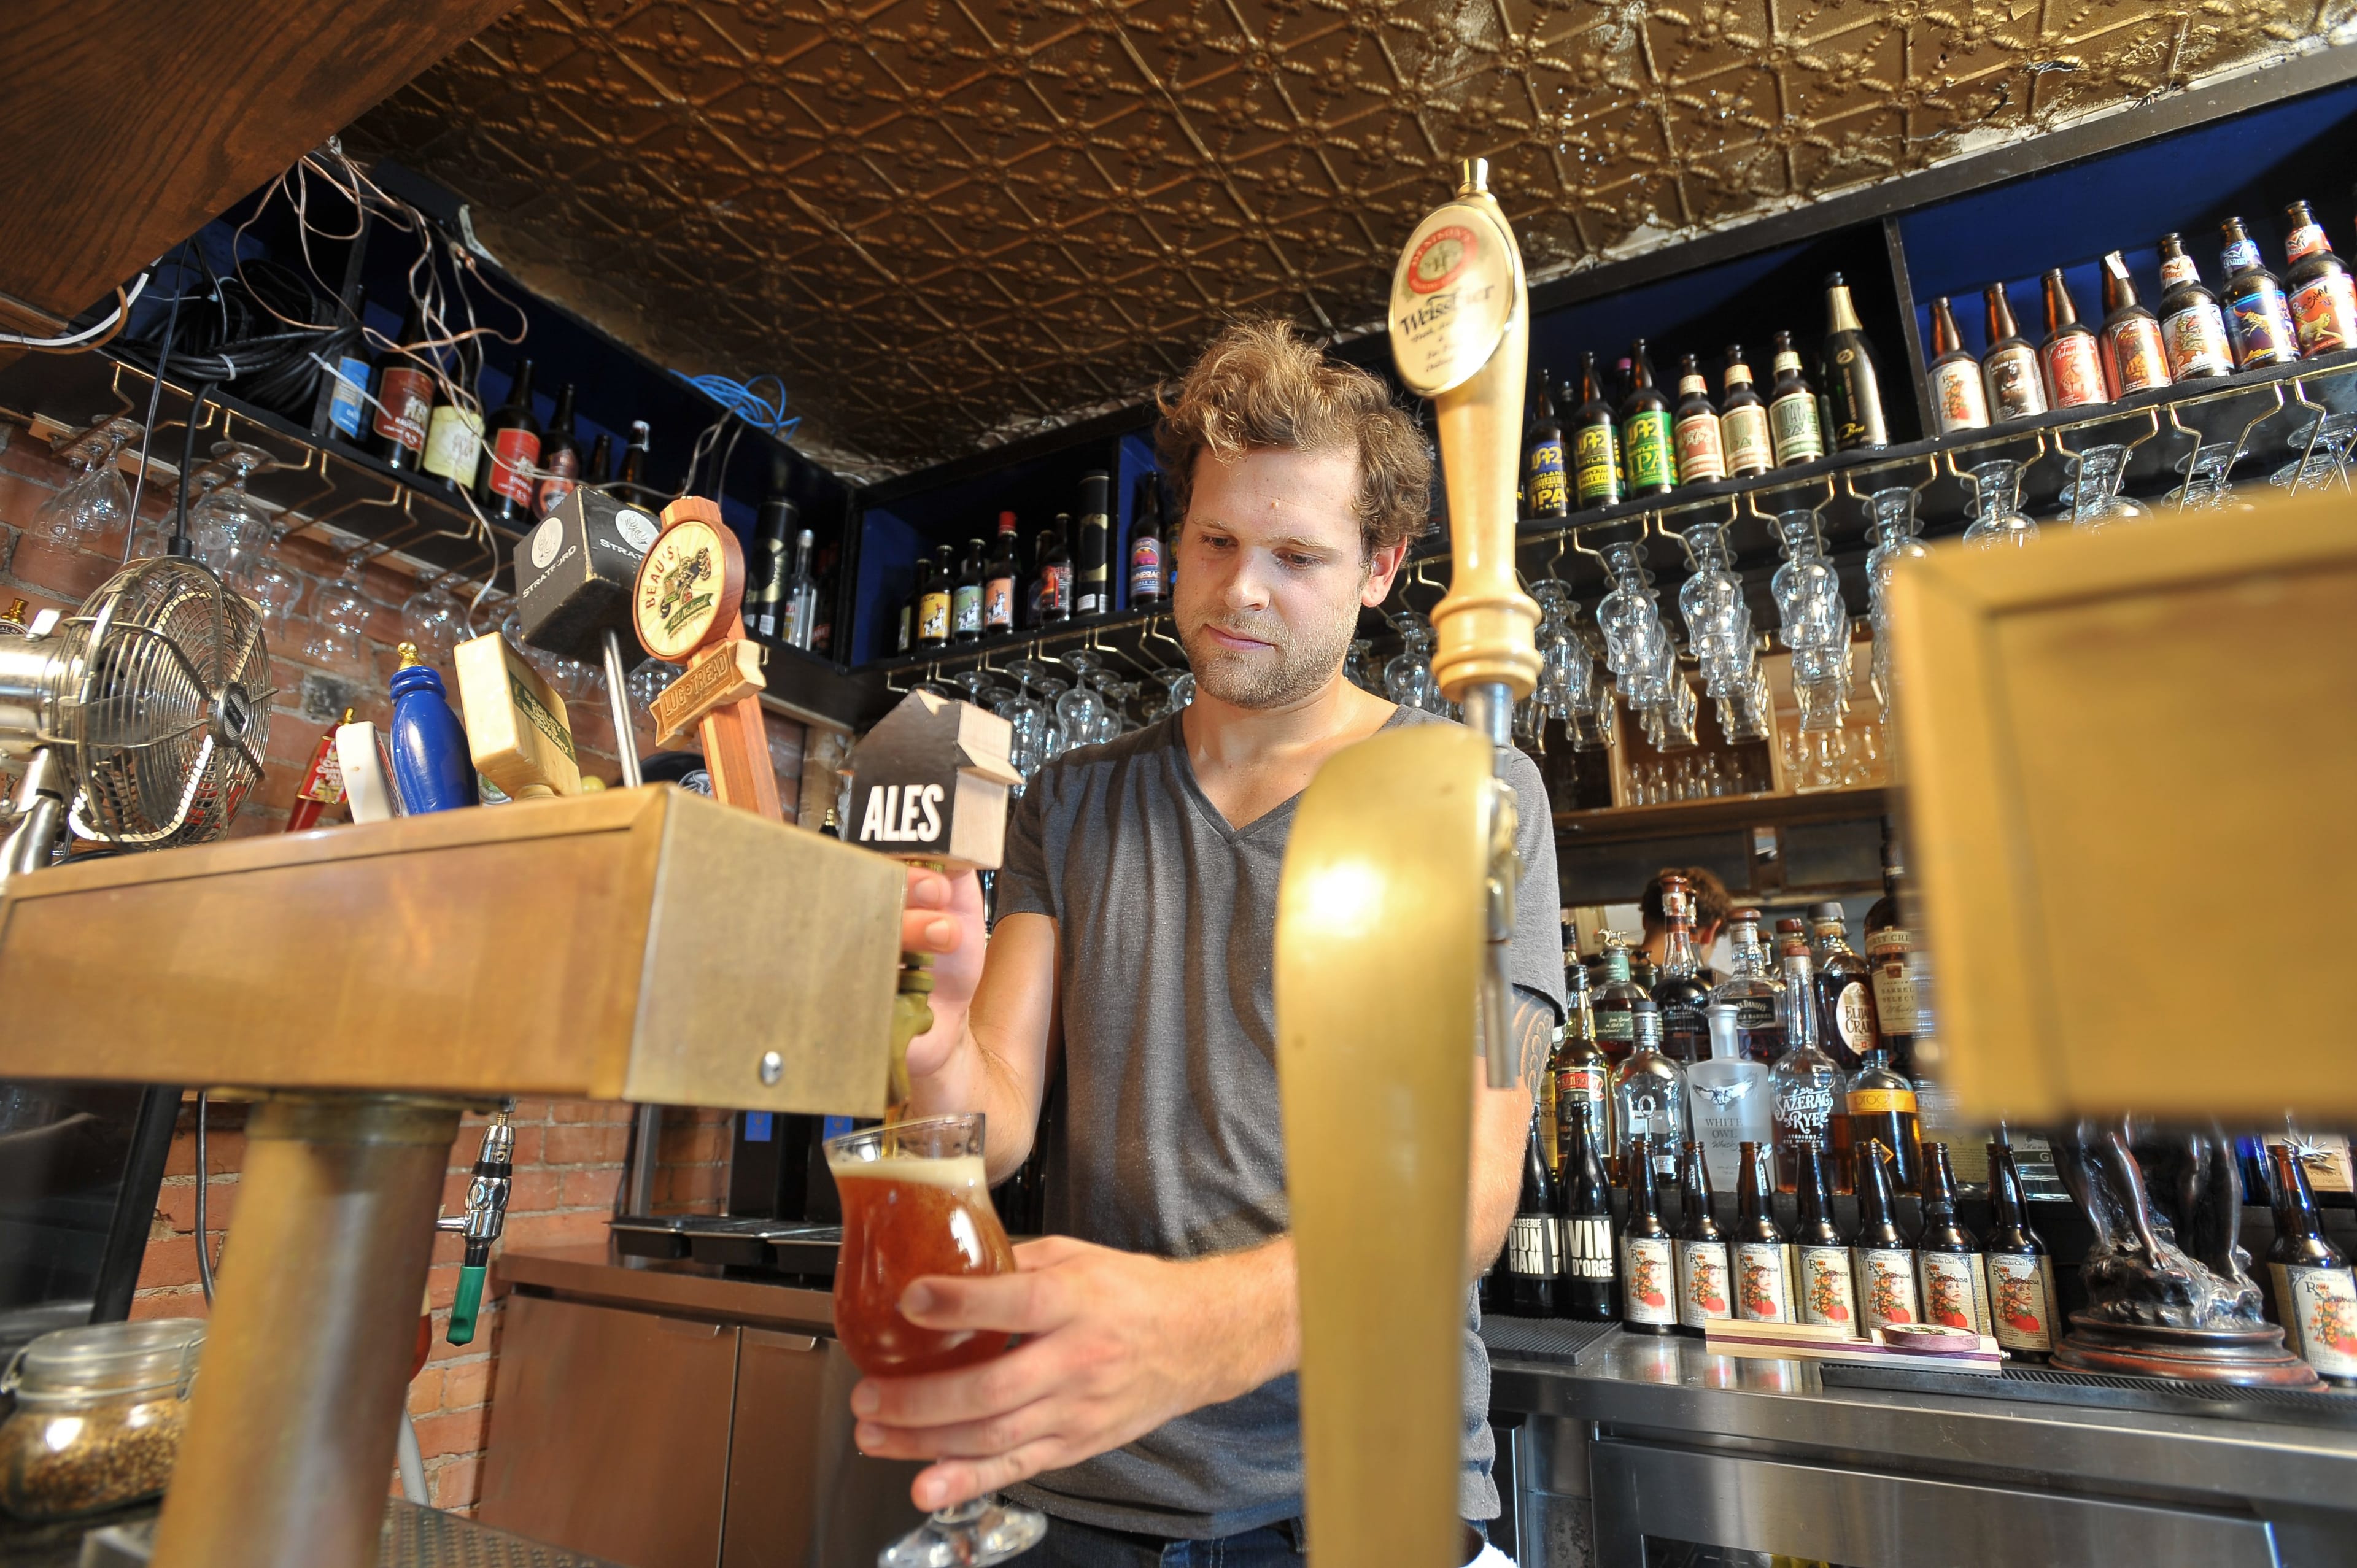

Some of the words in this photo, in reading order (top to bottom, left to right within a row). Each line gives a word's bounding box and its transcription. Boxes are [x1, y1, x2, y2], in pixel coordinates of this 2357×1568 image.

[599, 539, 644, 561] STRAT
[645, 545, 674, 610] BEAU'S
[859, 784, 945, 842] ALES
[1775, 1092, 1833, 1122] SAZERAC
[1705, 1118, 1743, 1127] WHITE
[1712, 1129, 1738, 1138] OWL
[1789, 1110, 1830, 1134] RYE
[1509, 1227, 1543, 1251] DUN
[1567, 1220, 1612, 1259] VIN
[1510, 1250, 1544, 1275] HAM
[1572, 1259, 1614, 1278] D'ORGE
